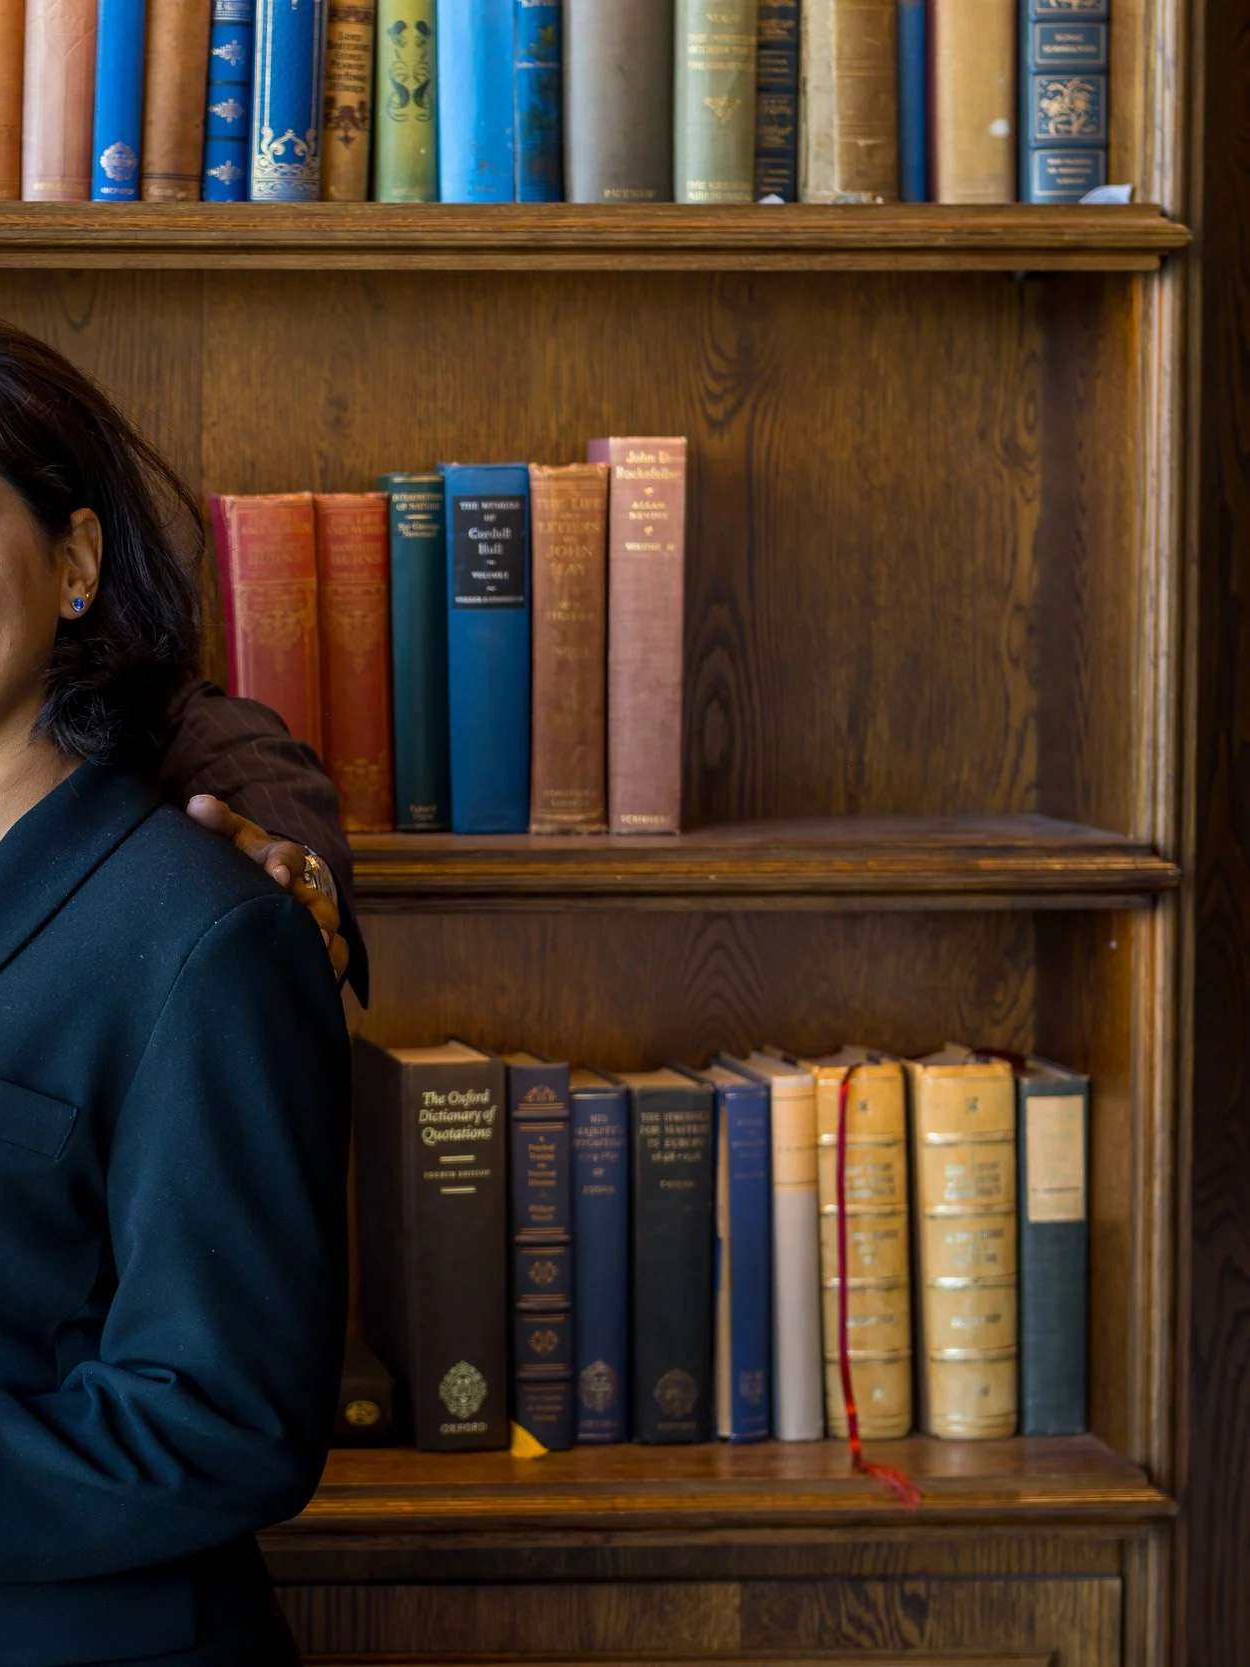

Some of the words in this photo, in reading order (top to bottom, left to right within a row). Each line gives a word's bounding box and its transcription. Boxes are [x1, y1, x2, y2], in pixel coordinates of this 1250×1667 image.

[626, 450, 656, 464] John
[460, 501, 478, 510] THE
[478, 542, 505, 555] Hull
[422, 1091, 447, 1106] The
[448, 1088, 490, 1109] Oxford
[418, 1108, 482, 1126] Dictionary
[483, 1104, 498, 1125] of
[421, 1125, 494, 1146] Quotations
[440, 1422, 488, 1435] OXFORD
